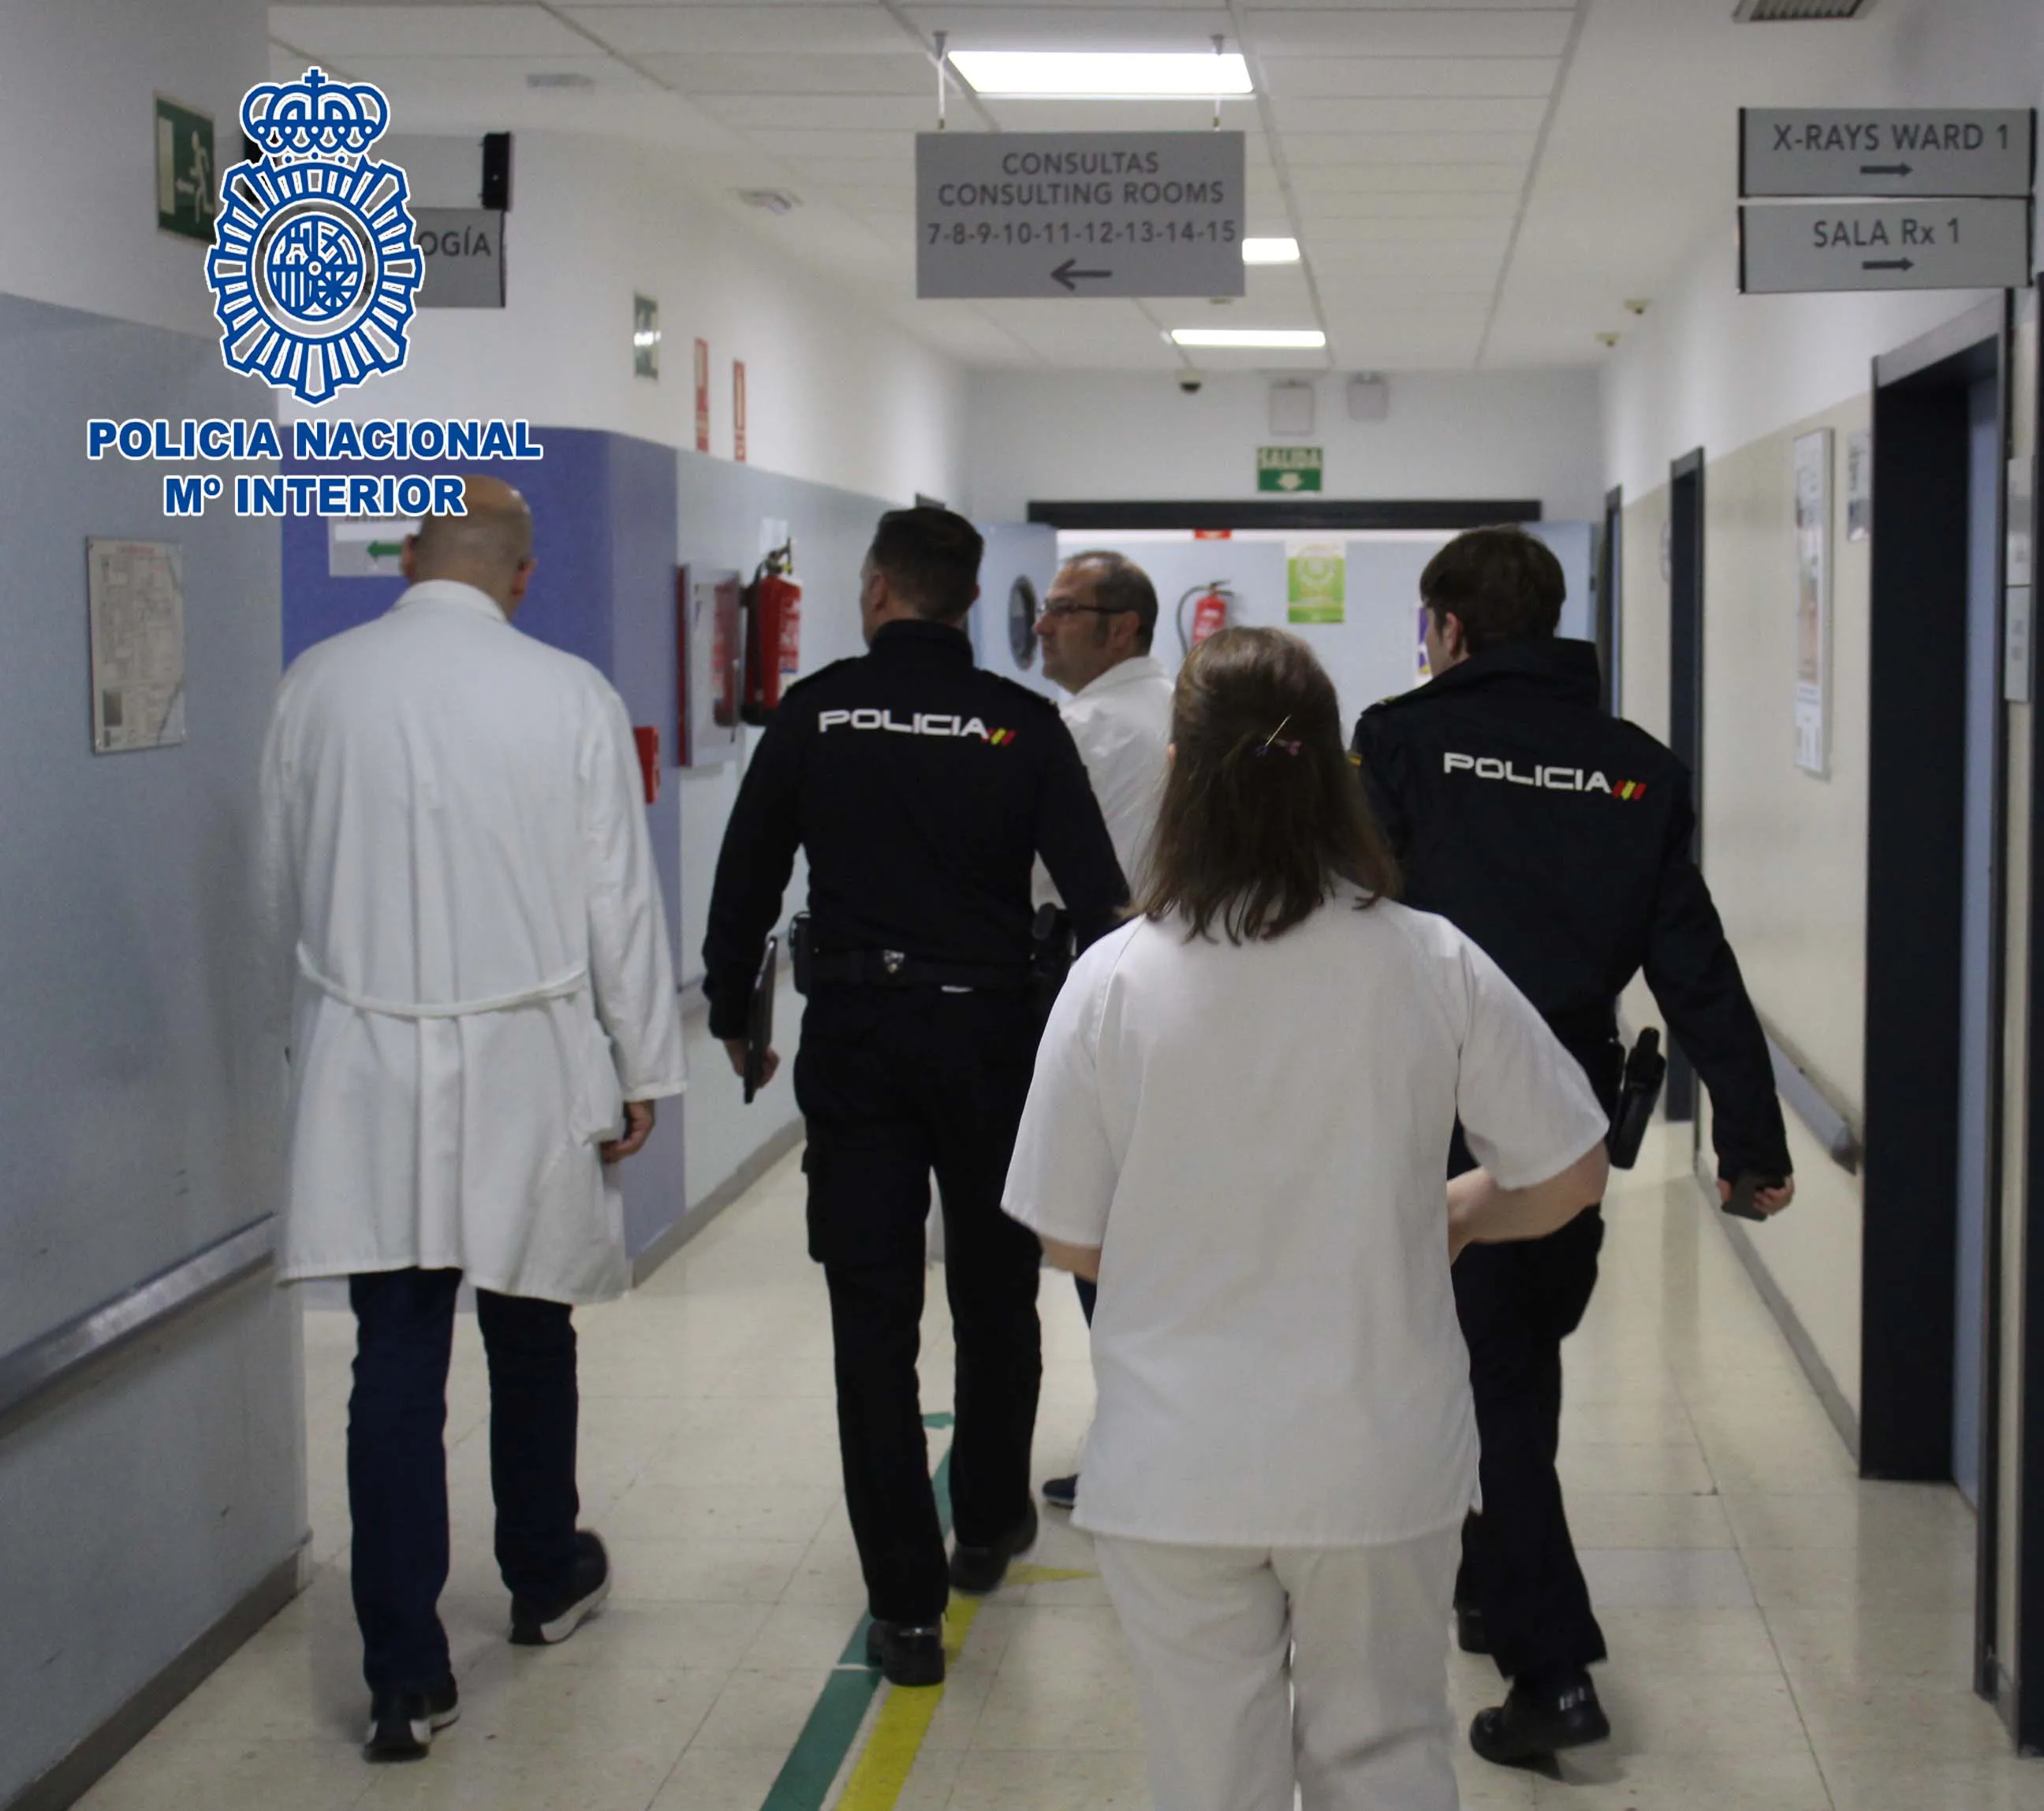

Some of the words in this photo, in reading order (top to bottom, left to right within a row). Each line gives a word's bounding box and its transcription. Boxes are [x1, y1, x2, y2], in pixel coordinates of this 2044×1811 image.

[1773, 123, 1880, 151] X-RAYS
[1890, 122, 1984, 151] WARD
[1996, 123, 2009, 151] 1
[1001, 151, 1160, 177] CONSULTAS
[938, 181, 1113, 207] CONSULTING
[1123, 181, 1225, 206] ROOMS
[927, 220, 1236, 245] 7-8-9-10-11-12-13-14-15
[1812, 219, 1890, 248] SALA
[1900, 218, 1935, 246] Rx
[1946, 217, 1960, 244] 1
[818, 708, 990, 740] POLICIA
[1443, 751, 1613, 795] POLICIA
